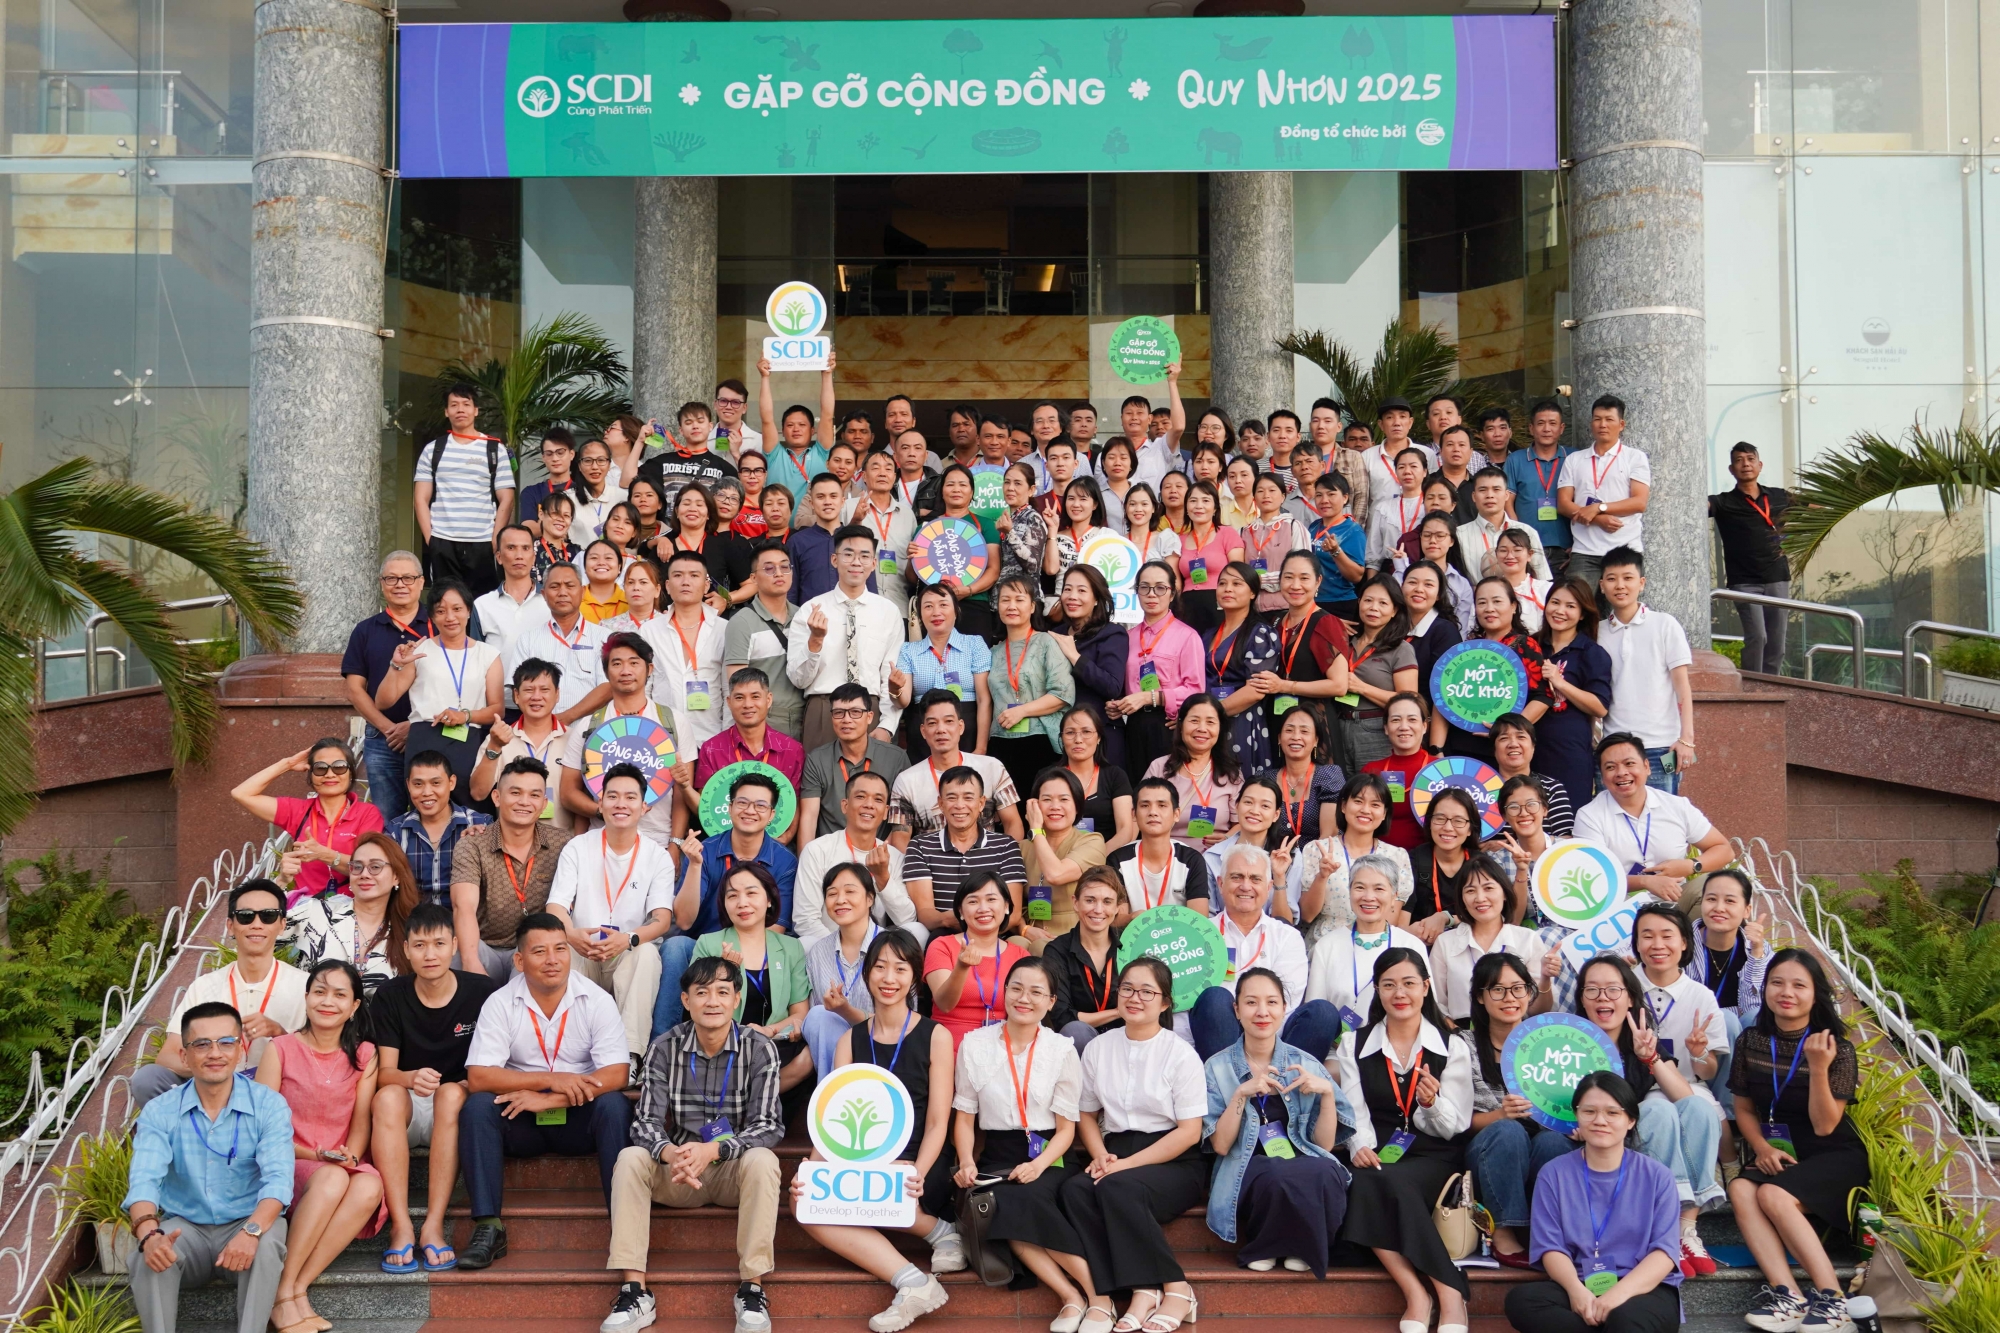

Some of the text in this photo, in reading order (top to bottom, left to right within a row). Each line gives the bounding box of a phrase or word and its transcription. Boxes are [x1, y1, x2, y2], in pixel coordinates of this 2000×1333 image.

[567, 74, 652, 104] SCDI
[724, 66, 1106, 117] GẶP GỠ CỘNG ĐỒNG
[1357, 73, 1443, 102] 2025
[598, 105, 624, 115] Phát
[1280, 122, 1406, 140] Đồng tổ chức bởi
[770, 340, 823, 359] SCDI
[1120, 346, 1142, 355] CỘNG
[1129, 338, 1145, 347] GẶP
[978, 482, 1002, 498] MỘT
[945, 528, 967, 579] CỘNG ĐỒNG
[1464, 663, 1498, 684] MỘT
[1445, 681, 1475, 699] SỨC
[600, 741, 632, 760] CỘNG
[633, 747, 665, 770] ĐỒNG
[1145, 936, 1188, 958] GẶP GỠ
[1170, 947, 1205, 964] ĐỒNG
[1545, 1044, 1587, 1070] MỘT
[1521, 1061, 1557, 1085] SỨC
[810, 1168, 904, 1204] SCDI
[809, 1204, 903, 1219] Develop Together
